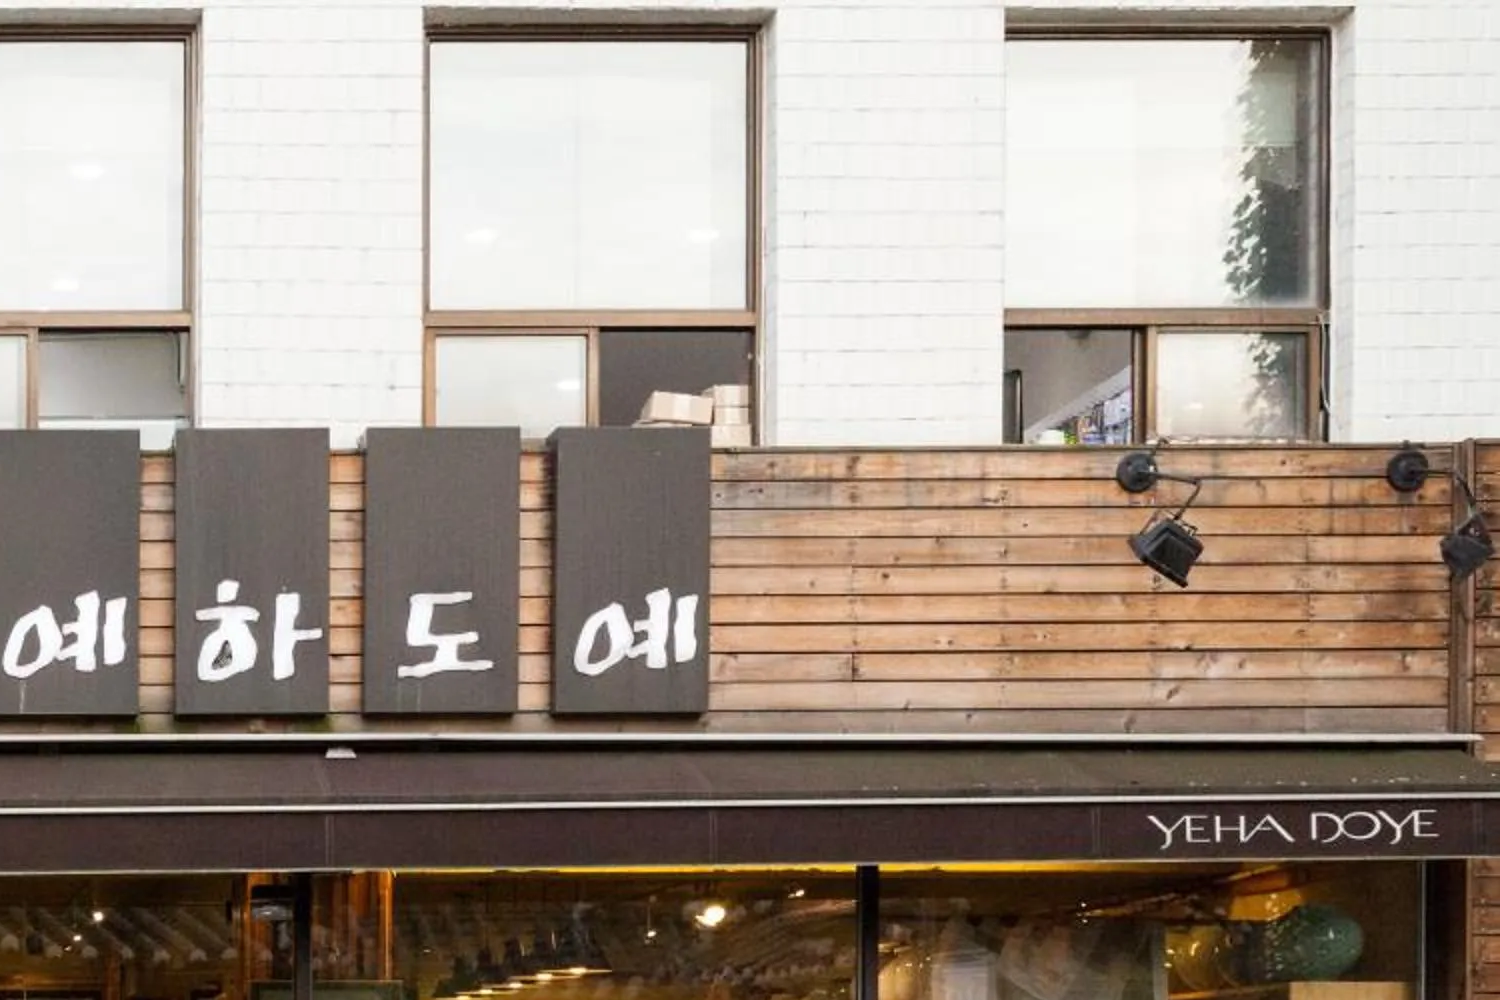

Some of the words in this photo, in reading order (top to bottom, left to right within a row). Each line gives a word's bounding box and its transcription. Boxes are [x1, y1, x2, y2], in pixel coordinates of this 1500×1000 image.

[2, 579, 700, 681] 예하도예
[1146, 813, 1296, 850] YEHA
[1309, 809, 1440, 845] DOYE
